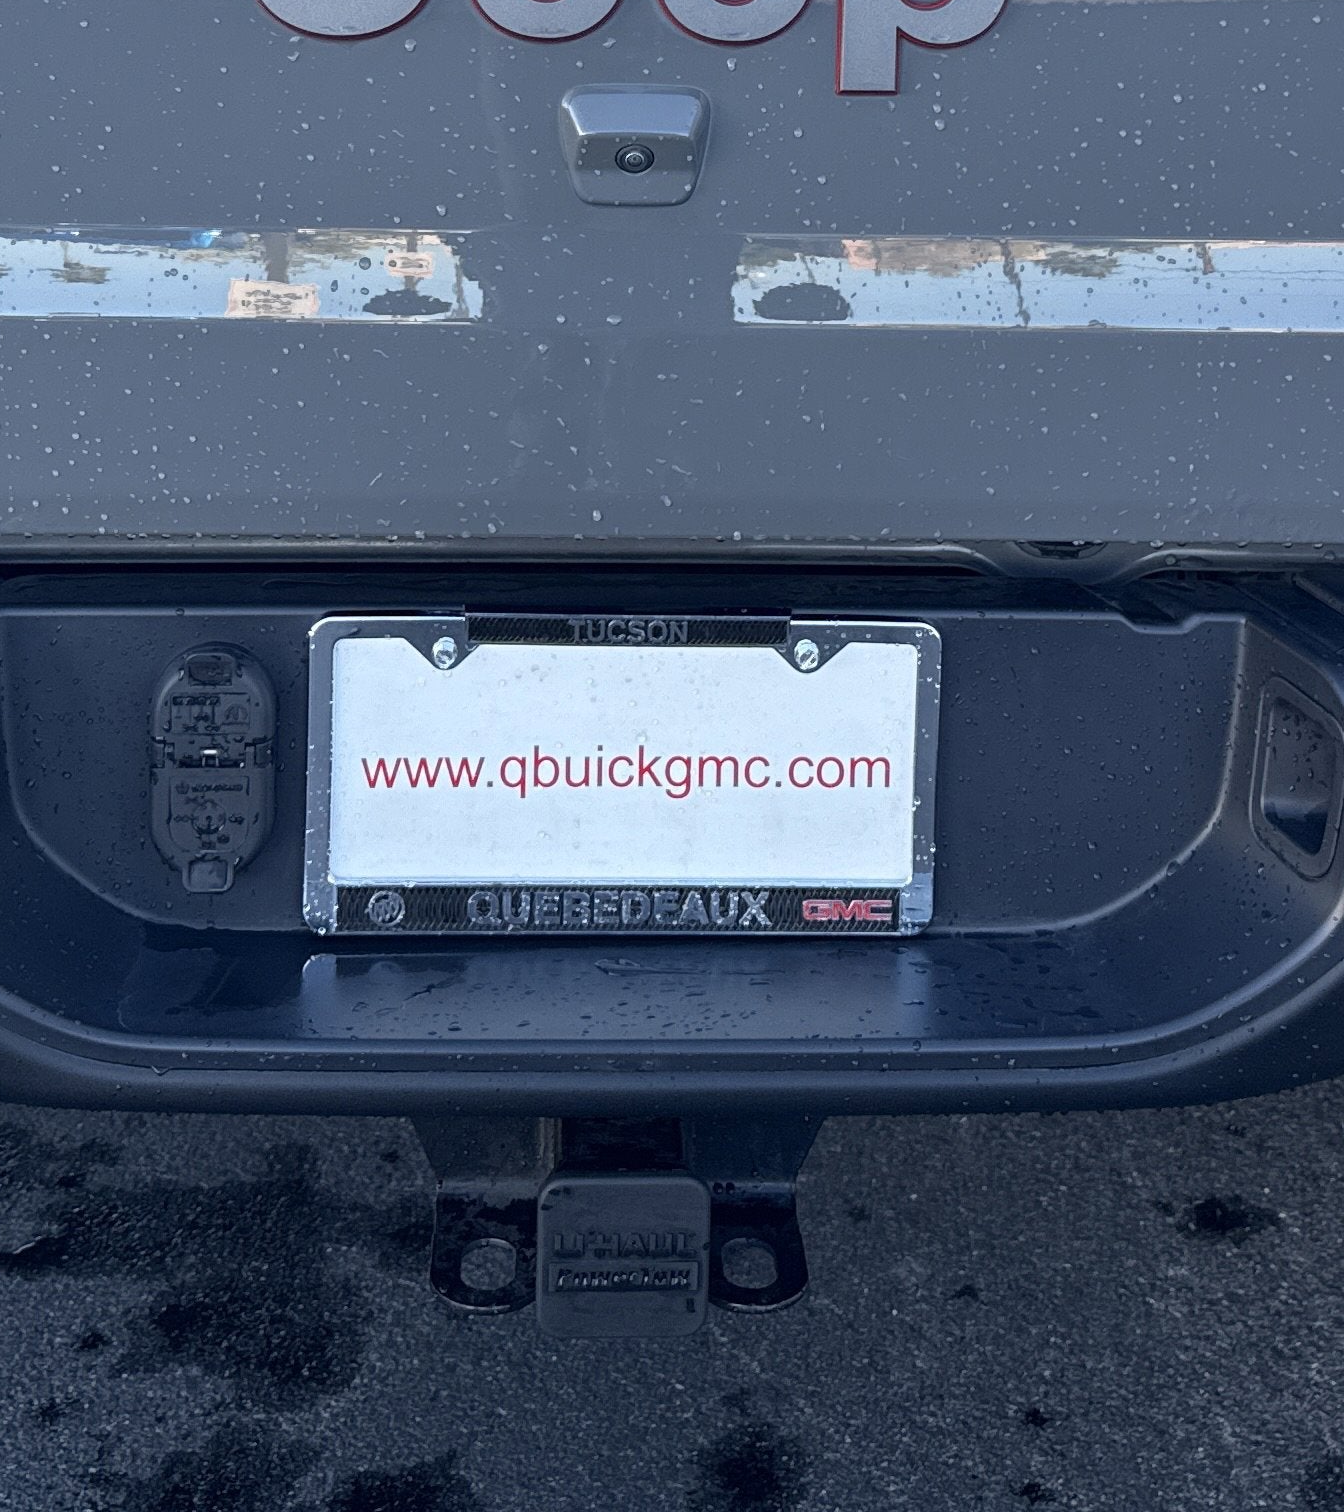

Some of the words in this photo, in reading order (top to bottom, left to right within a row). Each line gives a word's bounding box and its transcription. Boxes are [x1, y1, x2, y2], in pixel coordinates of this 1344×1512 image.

[568, 618, 689, 643] TUCSON
[361, 744, 891, 800] www.qbuickgmc.com
[466, 889, 773, 927] QUEBEDEAUX
[801, 898, 893, 922] GMC
